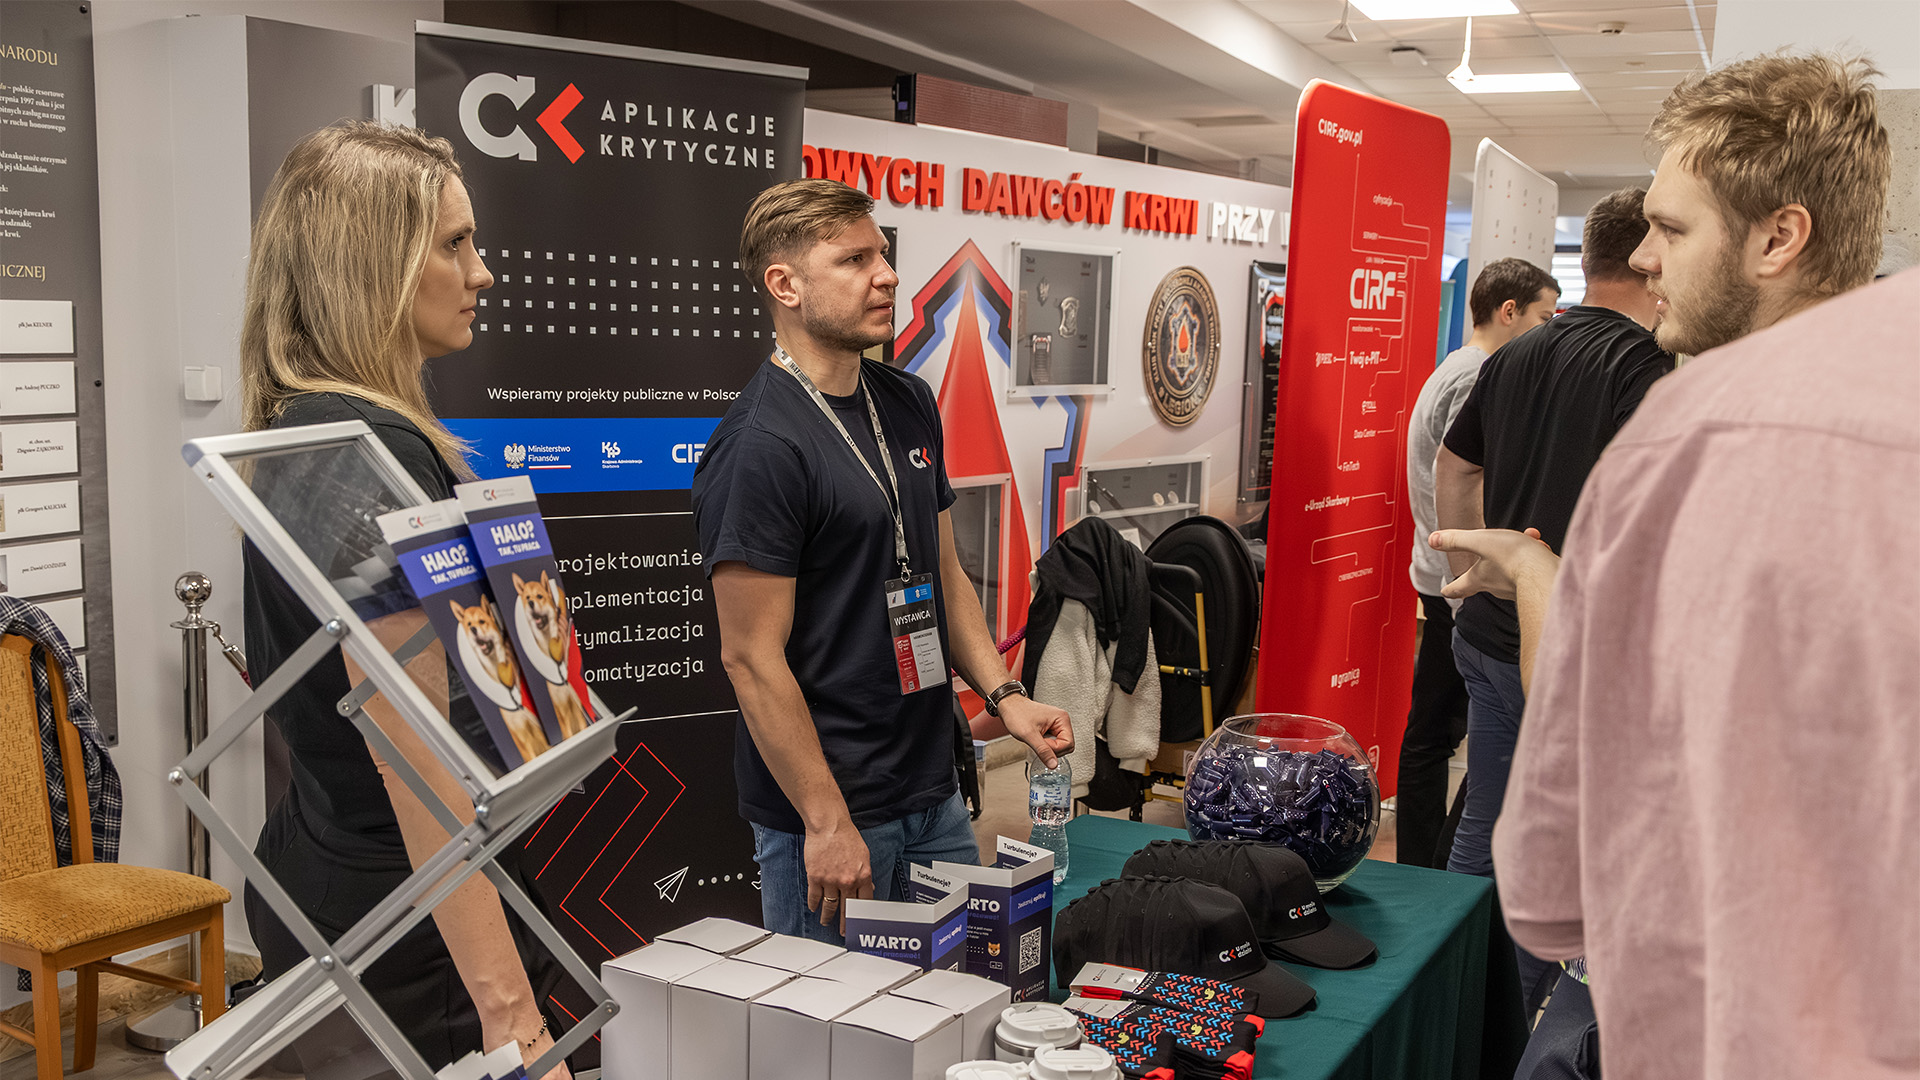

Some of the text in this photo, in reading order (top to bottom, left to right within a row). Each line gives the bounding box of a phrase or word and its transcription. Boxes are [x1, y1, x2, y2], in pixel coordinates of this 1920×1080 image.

[0, 44, 58, 66] NARODU
[13, 85, 34, 94] polskie
[35, 90, 64, 98] resortowe
[21, 96, 34, 104] 1997
[36, 100, 49, 108] roku
[54, 101, 65, 110] jest
[22, 109, 41, 119] zasług
[600, 99, 776, 138] APLIKACJE
[10, 119, 28, 127] ruchu
[29, 120, 66, 133] honorowego
[1318, 118, 1363, 147] CIRF.gov.pl
[23, 154, 39, 162] może
[40, 157, 67, 165] otrzymać
[600, 134, 776, 170] KRYTYCZNE
[4, 163, 49, 174] jej składników.
[5, 207, 22, 218] której
[23, 208, 41, 217] dawca
[42, 210, 56, 218] krwi
[962, 172, 1115, 225] DAWCÓW
[1124, 191, 1199, 235] KRWI
[1208, 202, 1275, 243] PRZY
[1350, 268, 1396, 310] CIRF
[1350, 351, 1380, 368] Twój e-PIT
[487, 387, 562, 402] Wspieramy
[566, 388, 620, 402] projekty
[623, 388, 684, 402] publiczne
[687, 391, 699, 400] w
[528, 445, 571, 453] Ministerstwo
[528, 453, 560, 462] Finansów
[1305, 494, 1350, 512] e-Urząd Skarbowy
[490, 520, 535, 545] HALO?
[421, 544, 470, 573] HALO?
[497, 546, 515, 556] TAK,
[554, 548, 703, 575] rojektowanie
[431, 573, 450, 584] TAK,
[894, 610, 931, 626] WYSTAWCA
[584, 656, 704, 683] omatyzacja
[1004, 843, 1037, 858] Turbulencje?
[917, 871, 951, 887] Turbulencje?
[859, 934, 922, 951] WARTO
